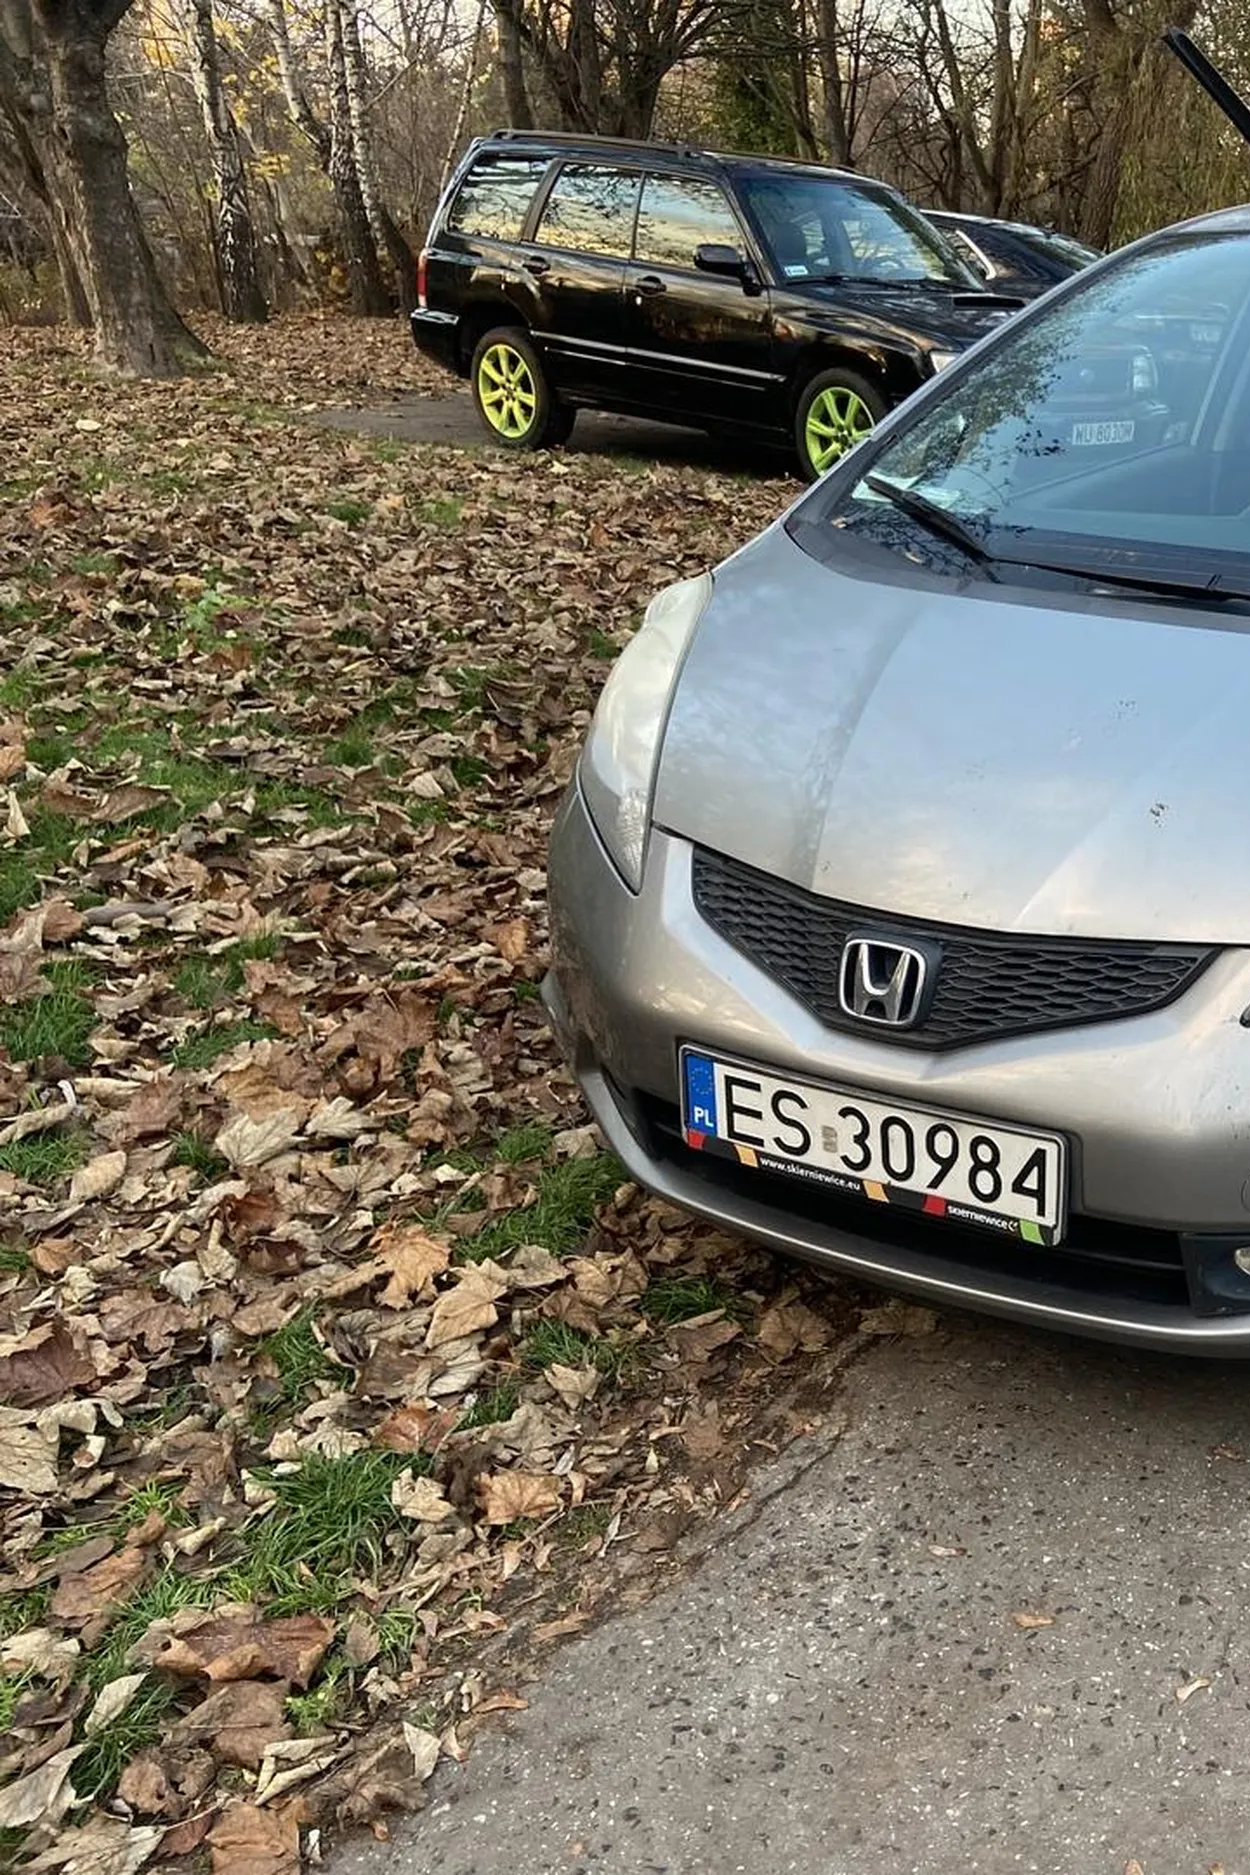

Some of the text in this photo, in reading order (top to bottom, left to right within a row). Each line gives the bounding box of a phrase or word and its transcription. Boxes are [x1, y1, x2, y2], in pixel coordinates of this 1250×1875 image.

[693, 1105, 715, 1128] PL
[724, 1074, 1048, 1218] ES 30984
[759, 1156, 861, 1192] www.skierniewice.eu
